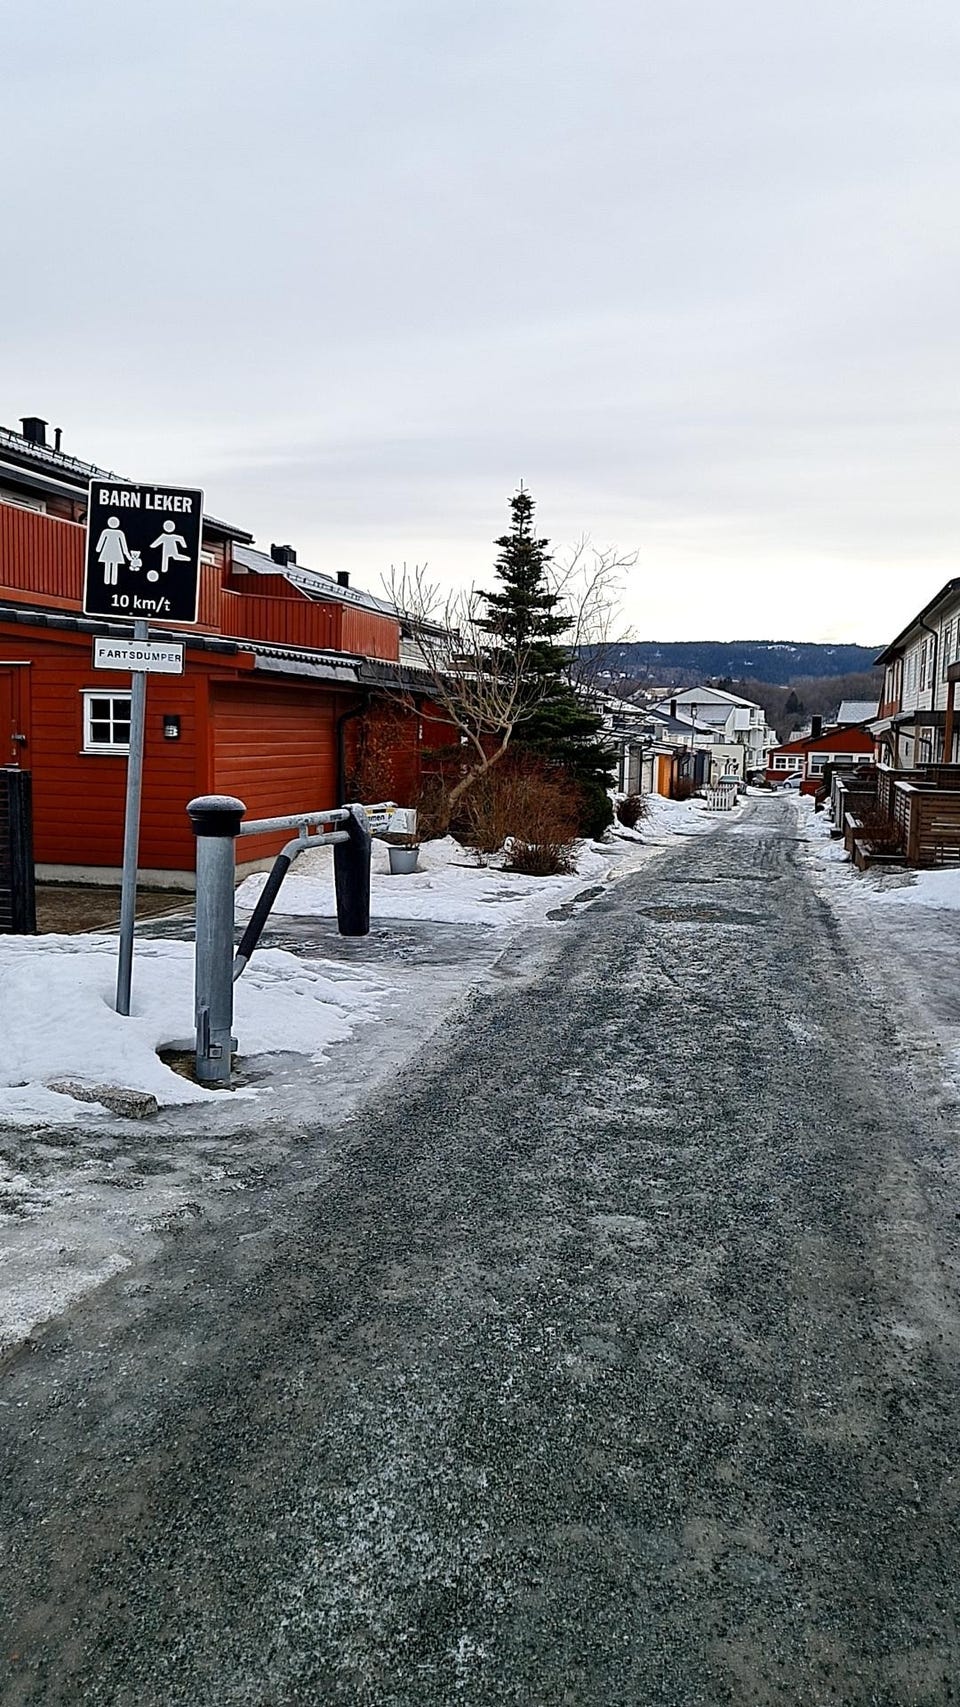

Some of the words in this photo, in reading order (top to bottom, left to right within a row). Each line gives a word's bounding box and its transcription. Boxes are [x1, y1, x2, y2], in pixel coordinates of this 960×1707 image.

[99, 489, 141, 509] BARN
[145, 493, 193, 513] LEKER
[111, 594, 130, 608] 10
[133, 595, 171, 613] km/t
[99, 649, 182, 662] FARTSDUMPER
